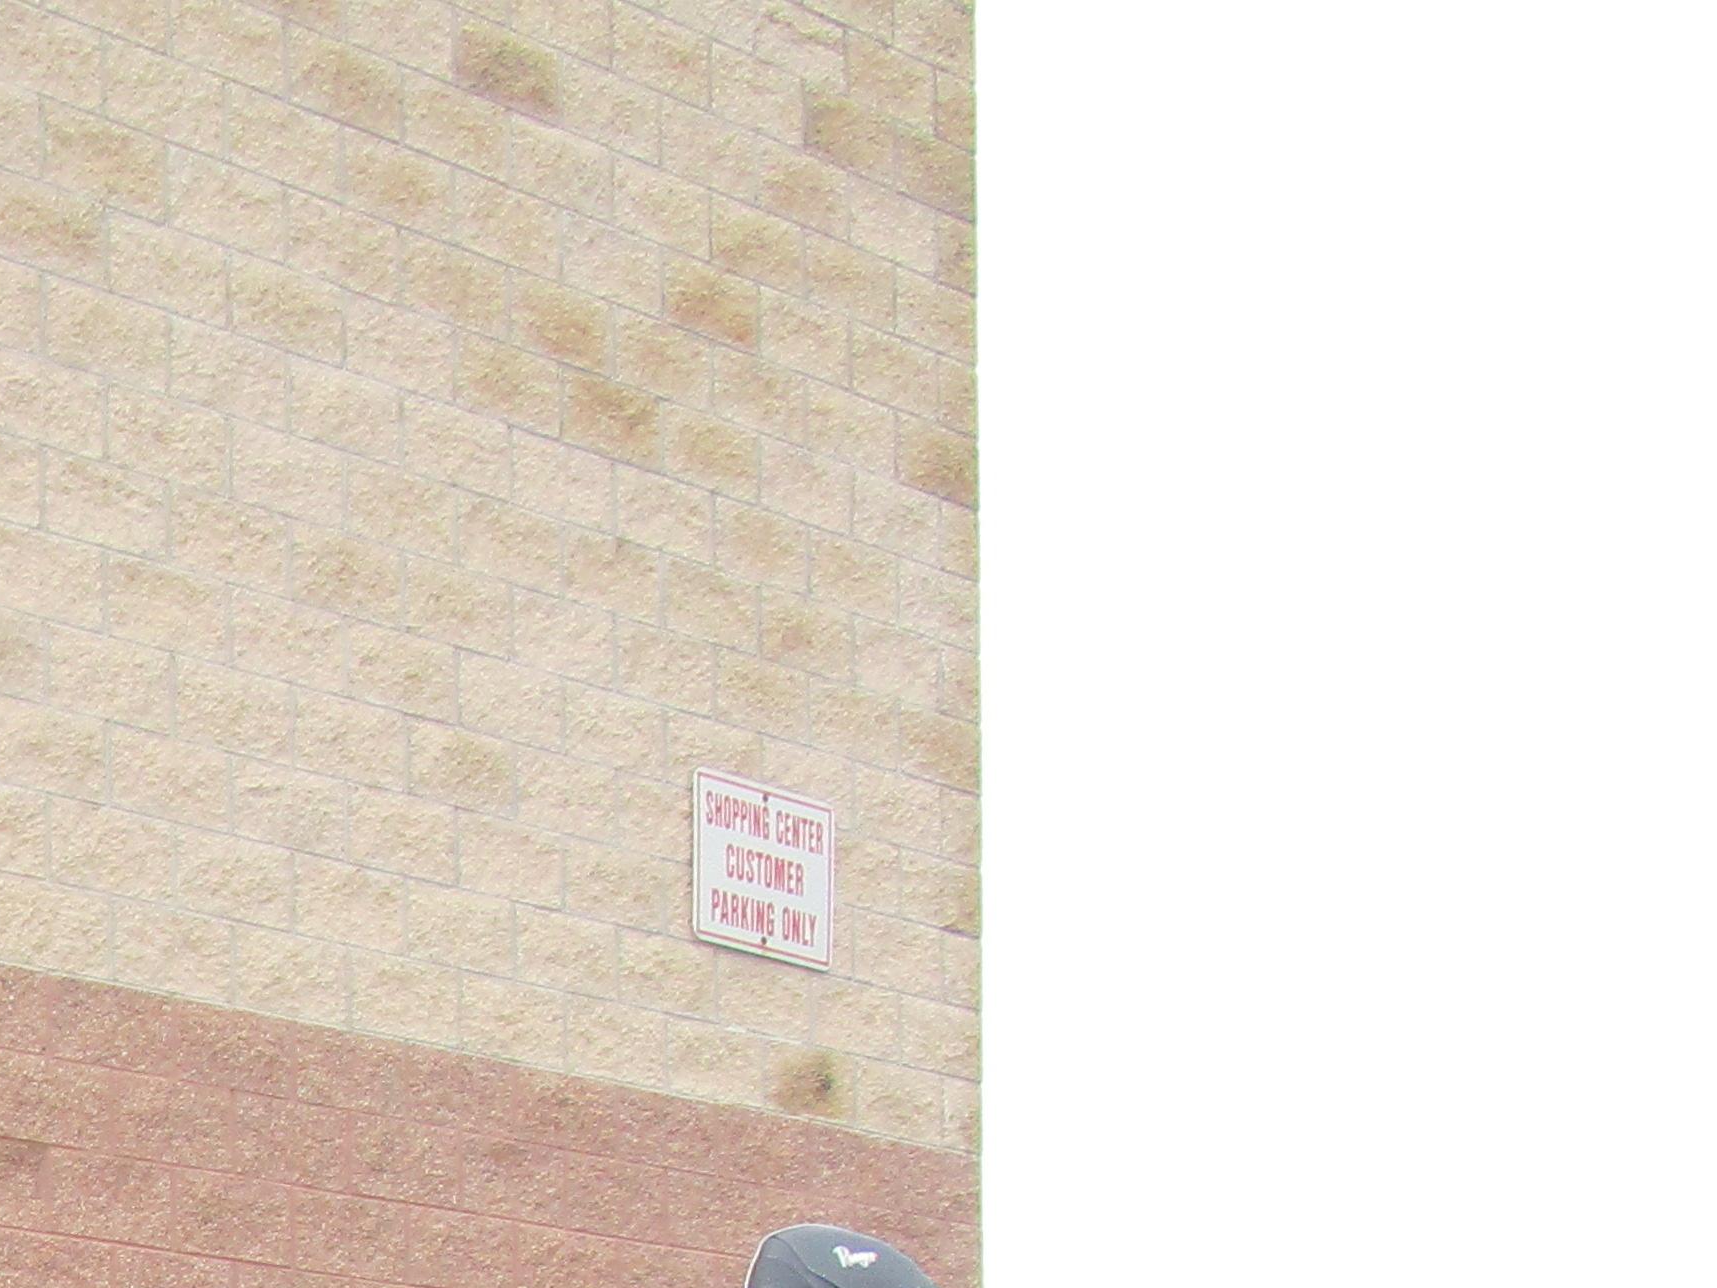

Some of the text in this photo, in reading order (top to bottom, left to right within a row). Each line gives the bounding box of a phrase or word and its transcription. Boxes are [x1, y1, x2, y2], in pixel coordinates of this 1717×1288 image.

[705, 789, 824, 856] SHOPPING CENTER
[725, 843, 805, 897] CUSTOMER
[710, 887, 818, 948] PARKING ONLY
